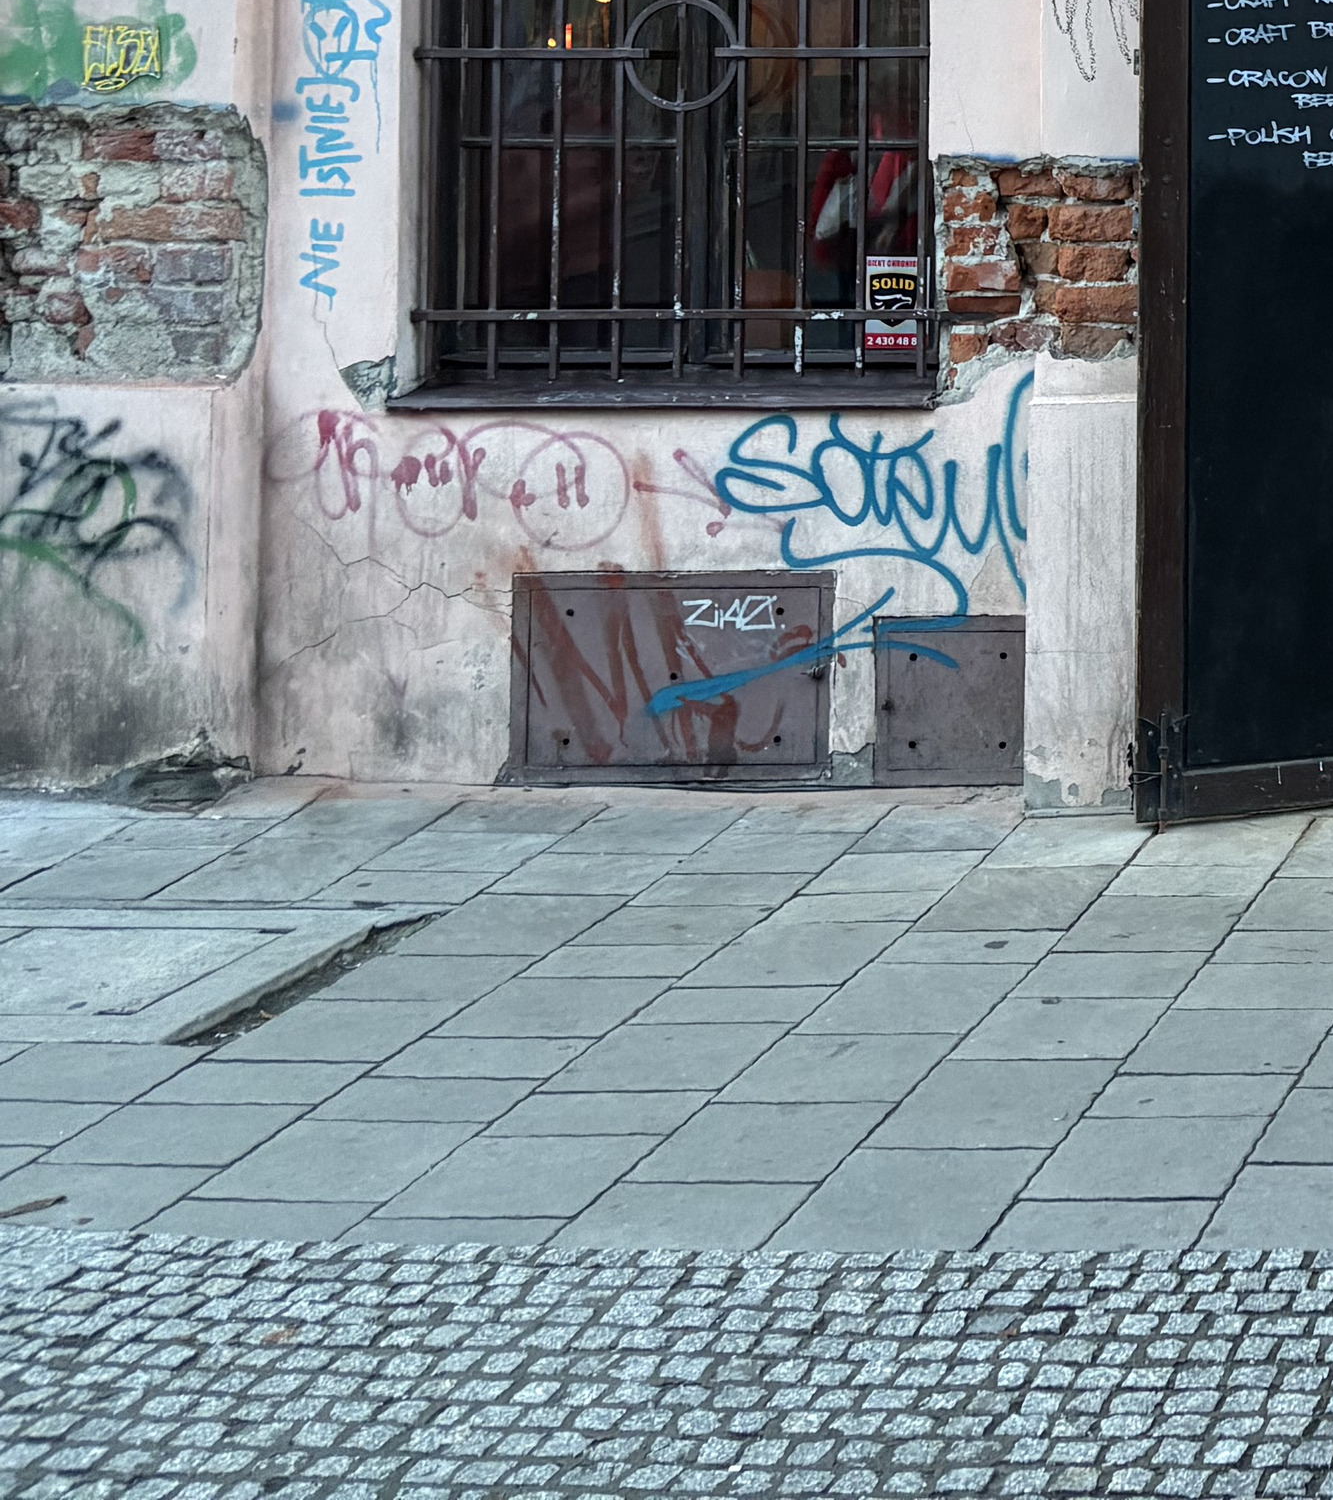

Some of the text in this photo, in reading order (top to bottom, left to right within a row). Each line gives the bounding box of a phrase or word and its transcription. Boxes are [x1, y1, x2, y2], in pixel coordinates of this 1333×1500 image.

[872, 278, 915, 290] SOLID
[867, 337, 873, 345] 2
[875, 337, 895, 345] 430
